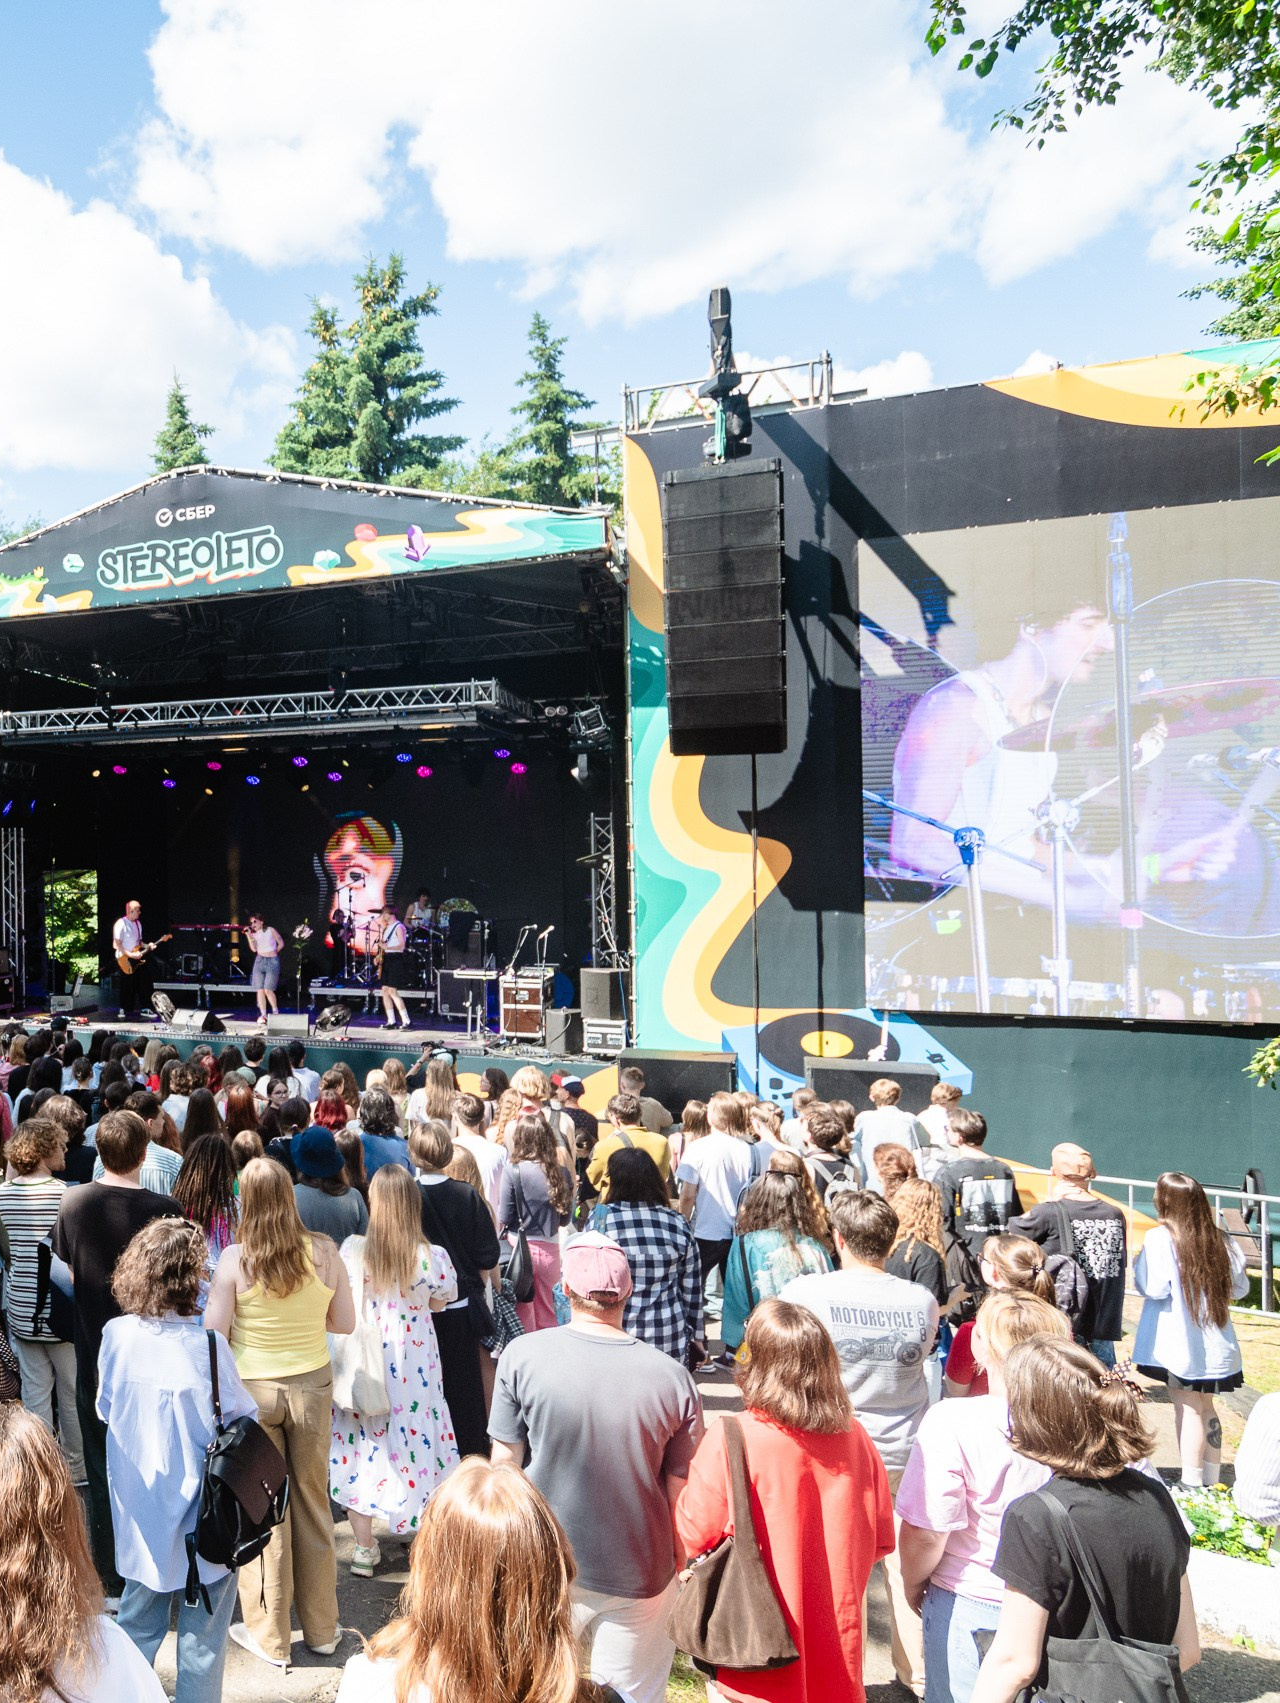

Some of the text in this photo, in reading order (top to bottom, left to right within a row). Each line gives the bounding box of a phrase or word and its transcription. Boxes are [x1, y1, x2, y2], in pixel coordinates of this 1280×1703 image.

[175, 504, 216, 522] СБЕР
[98, 526, 283, 587] STEREOLETO
[829, 1305, 914, 1328] MOTORCYCLE
